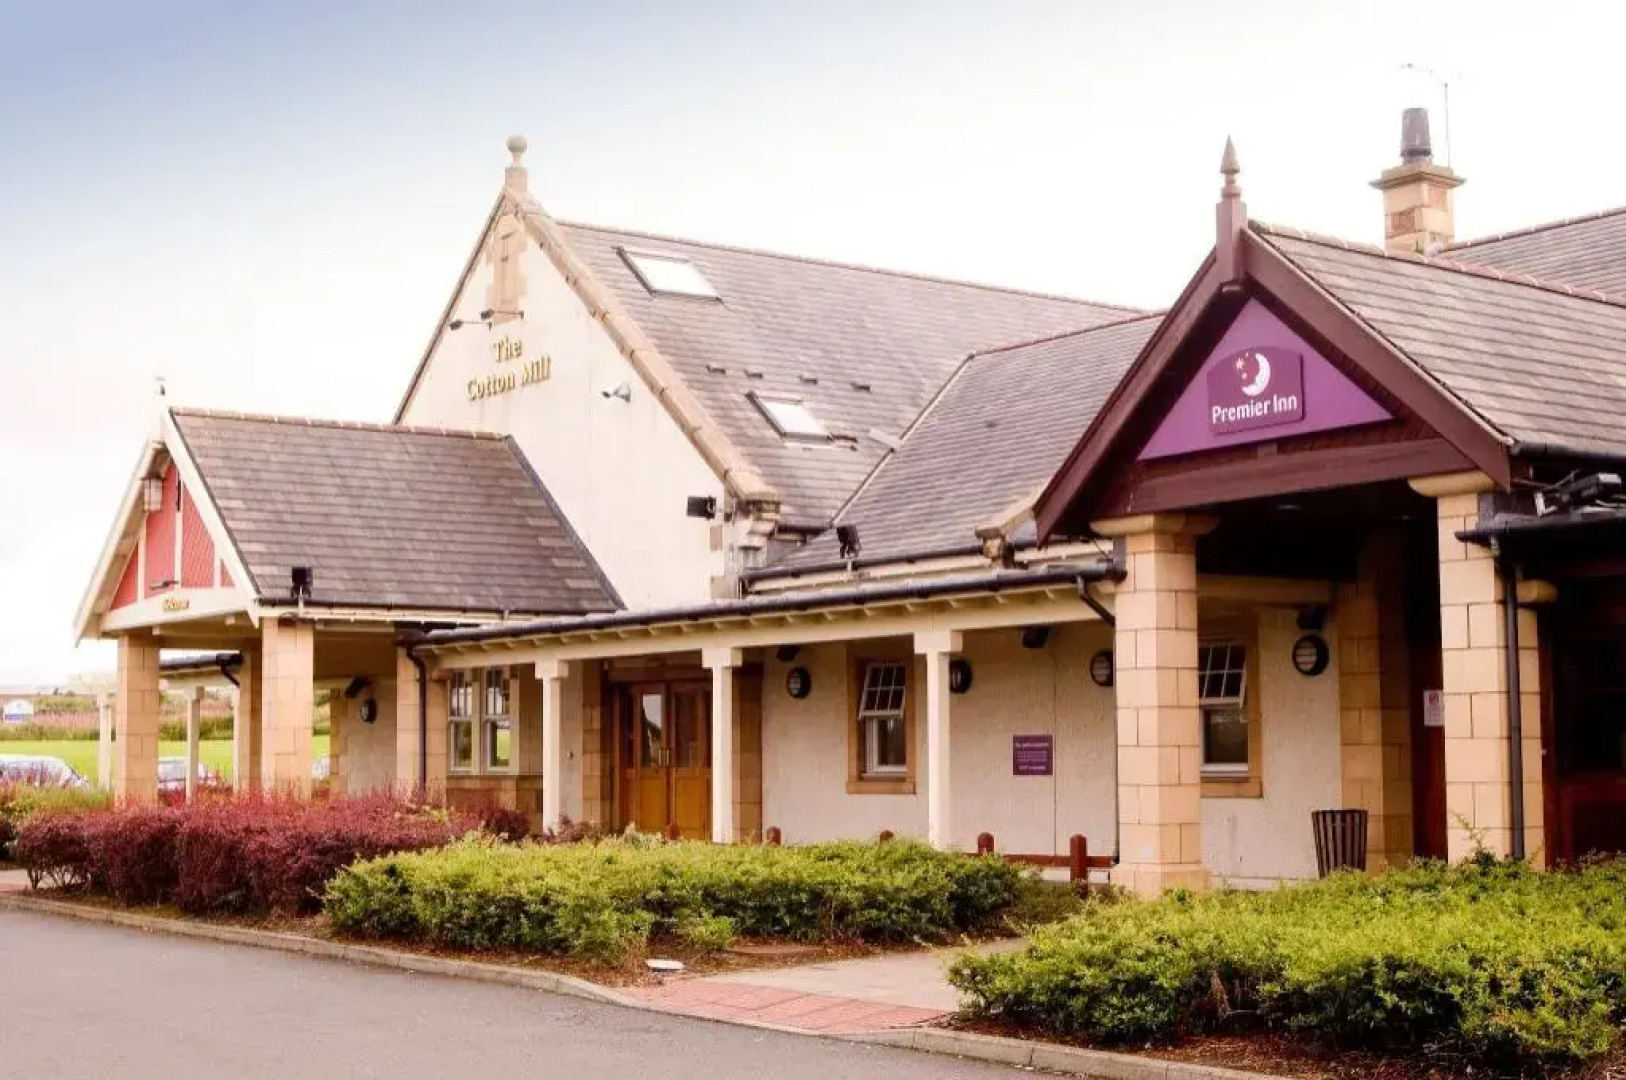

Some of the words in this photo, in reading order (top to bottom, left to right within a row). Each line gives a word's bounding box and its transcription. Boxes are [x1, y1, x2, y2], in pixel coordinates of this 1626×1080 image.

[492, 335, 522, 362] The
[466, 372, 515, 402] Cotton
[521, 355, 551, 387] Mill
[1212, 399, 1271, 424] Premier
[1272, 394, 1298, 414] Inn
